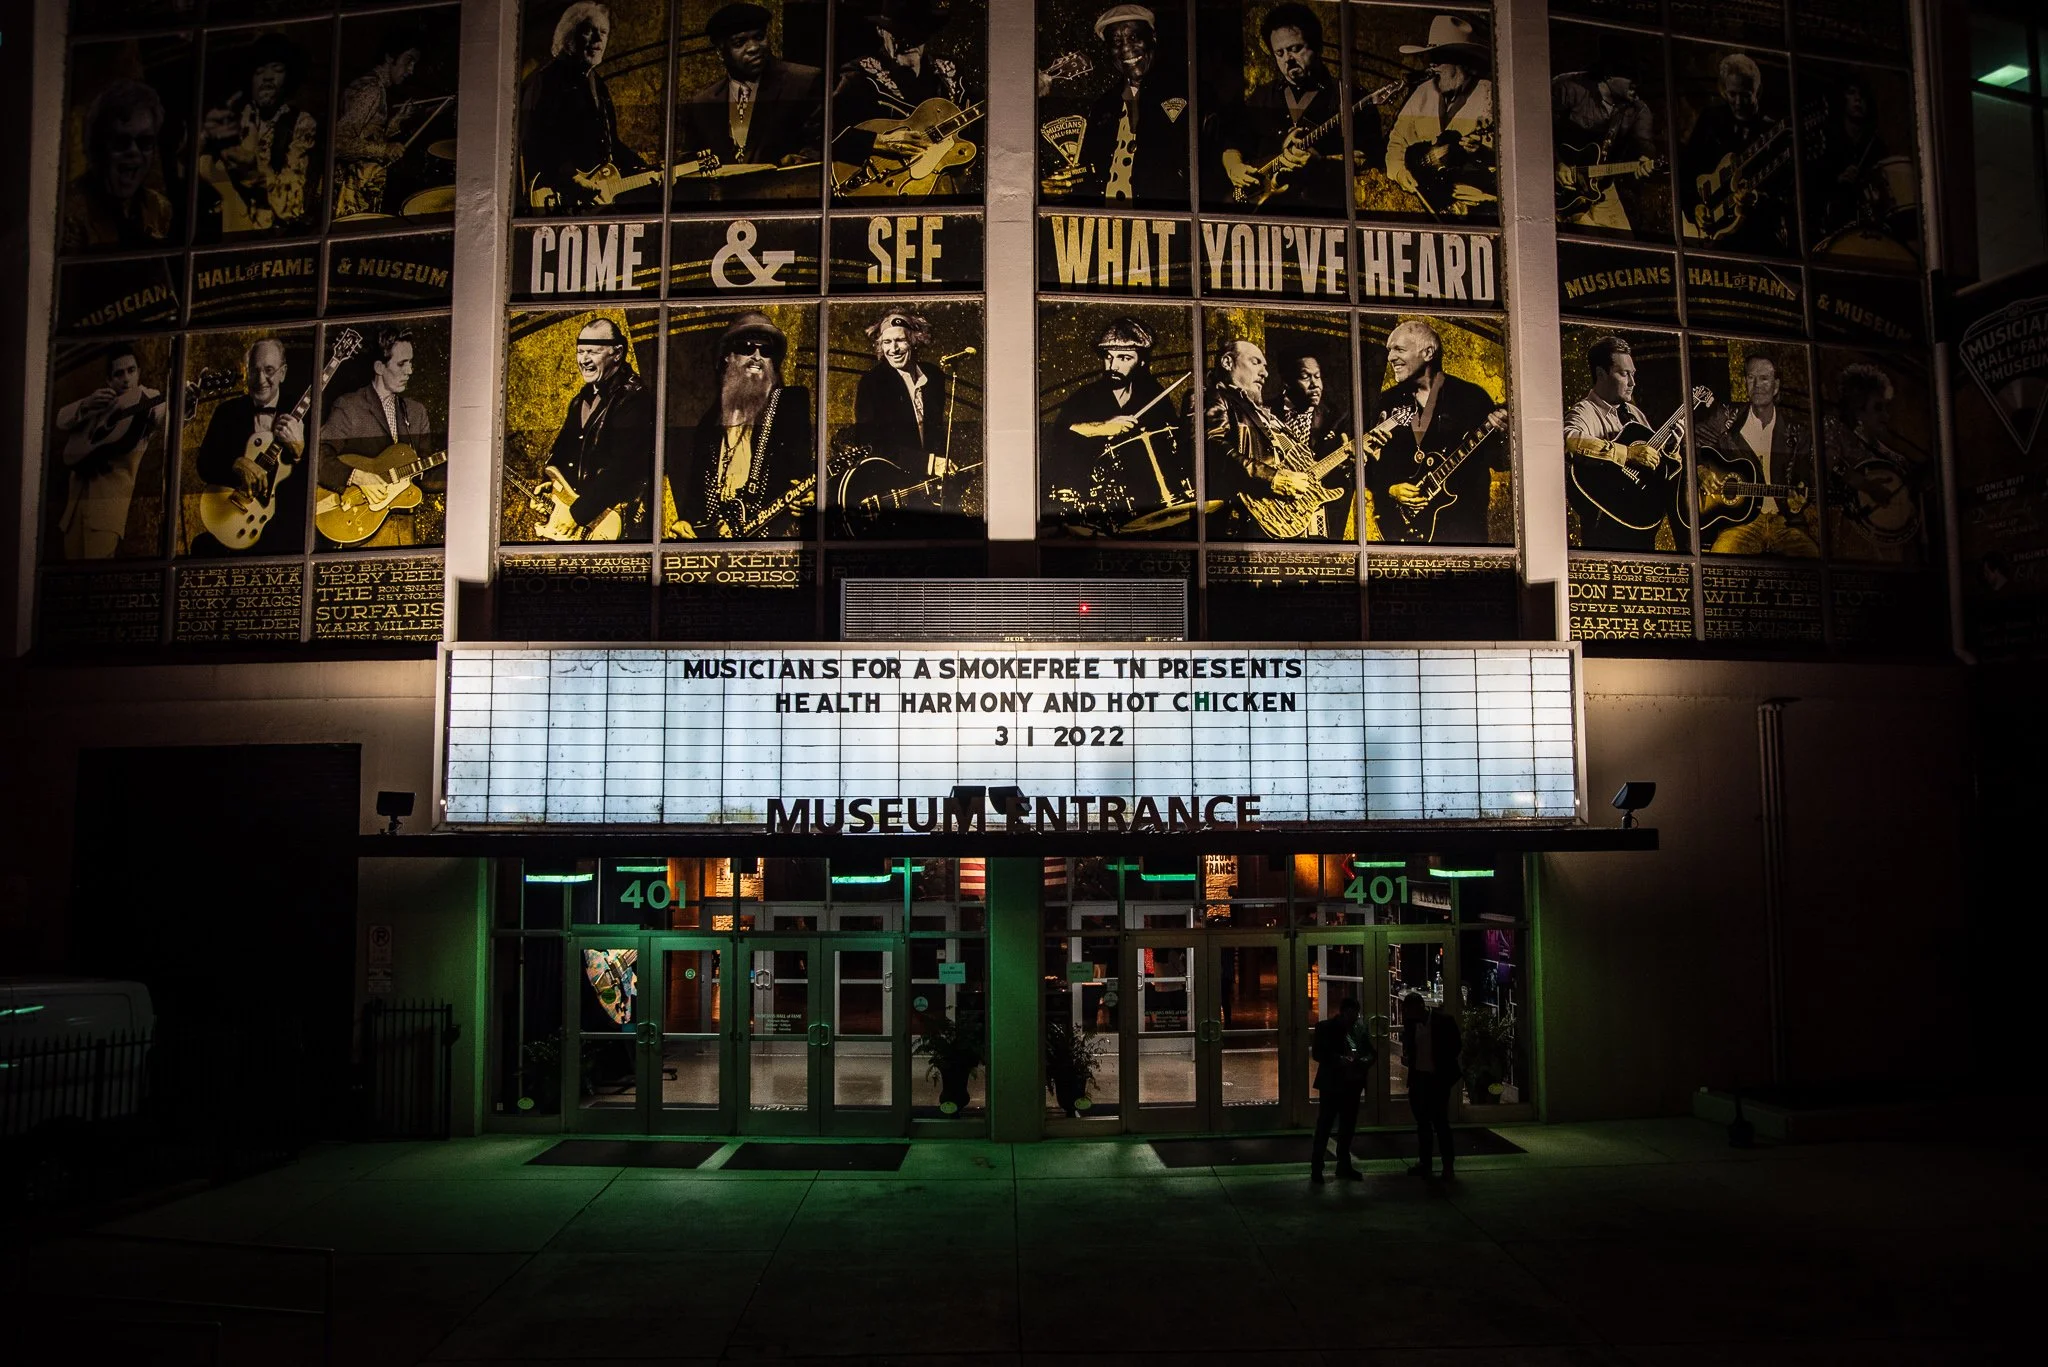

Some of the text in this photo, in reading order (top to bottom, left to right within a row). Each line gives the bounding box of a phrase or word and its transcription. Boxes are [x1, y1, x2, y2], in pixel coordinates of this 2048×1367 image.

[532, 216, 1496, 301] COME & SEE WHAT YOU'VE HEARD
[198, 267, 245, 290] HALL
[260, 257, 315, 280] FAME
[337, 257, 353, 275] &
[357, 257, 449, 289] MUSEUM
[1564, 265, 1672, 300] MUSICIANS
[1688, 267, 1733, 289] HALL
[1834, 299, 1913, 342] MUSEUM
[319, 560, 444, 574] LOU BRADLEY
[503, 556, 652, 568] STEVIE RAY VAUGHN
[663, 555, 722, 570] BEN
[1207, 554, 1356, 565] THE TENNESSEE TWO
[1368, 558, 1512, 569] THE MEMPHIS BOYS
[181, 565, 303, 577] ALLEN REYNOLDS
[318, 569, 444, 585] JERRY REED
[516, 566, 578, 575] DOUBLE
[580, 565, 652, 575] TROUBLE
[665, 571, 711, 584] ROY
[1206, 565, 1356, 577] CHARLIE DANIELS
[1368, 567, 1447, 580] DUANE
[1569, 563, 1690, 577] THE MUSCLE
[1702, 567, 1724, 576] THE
[179, 573, 303, 589] ALABAMA
[1568, 572, 1690, 584] SHOALS HORN SECTION
[1702, 576, 1750, 589] CHET
[1754, 578, 1820, 591] ATKINS
[178, 586, 302, 598] OWEN BRADLEY
[315, 585, 373, 602] THE
[377, 586, 400, 594] RON
[376, 592, 444, 602] REYNOLDS
[1568, 583, 1691, 603] DON EVERLY
[1703, 590, 1820, 607] WILL LEE
[178, 595, 302, 610] RICKY SKAGGS
[1569, 602, 1692, 616] STEVE WARINER
[177, 611, 221, 619] FELIX
[315, 601, 445, 621] SURFARIS
[1704, 607, 1746, 617] BILLY
[177, 617, 301, 633] DON FELDER
[316, 618, 444, 634] MARK MILLER
[1569, 616, 1693, 633] GARTH & THE
[1705, 619, 1744, 631] THE
[1569, 629, 1640, 641] BROOKS
[683, 657, 1303, 681] MUSICIANS FOR A SMOKEFREE TN PRESENTS
[775, 690, 1296, 714] HEALTH HARMONY AND HOT CHICKEN
[994, 725, 1009, 747] 3
[1053, 725, 1125, 747] 2022
[766, 794, 1263, 836] MUSEUM ENTRANCE
[619, 879, 687, 910] 401
[1343, 875, 1409, 905] 401
